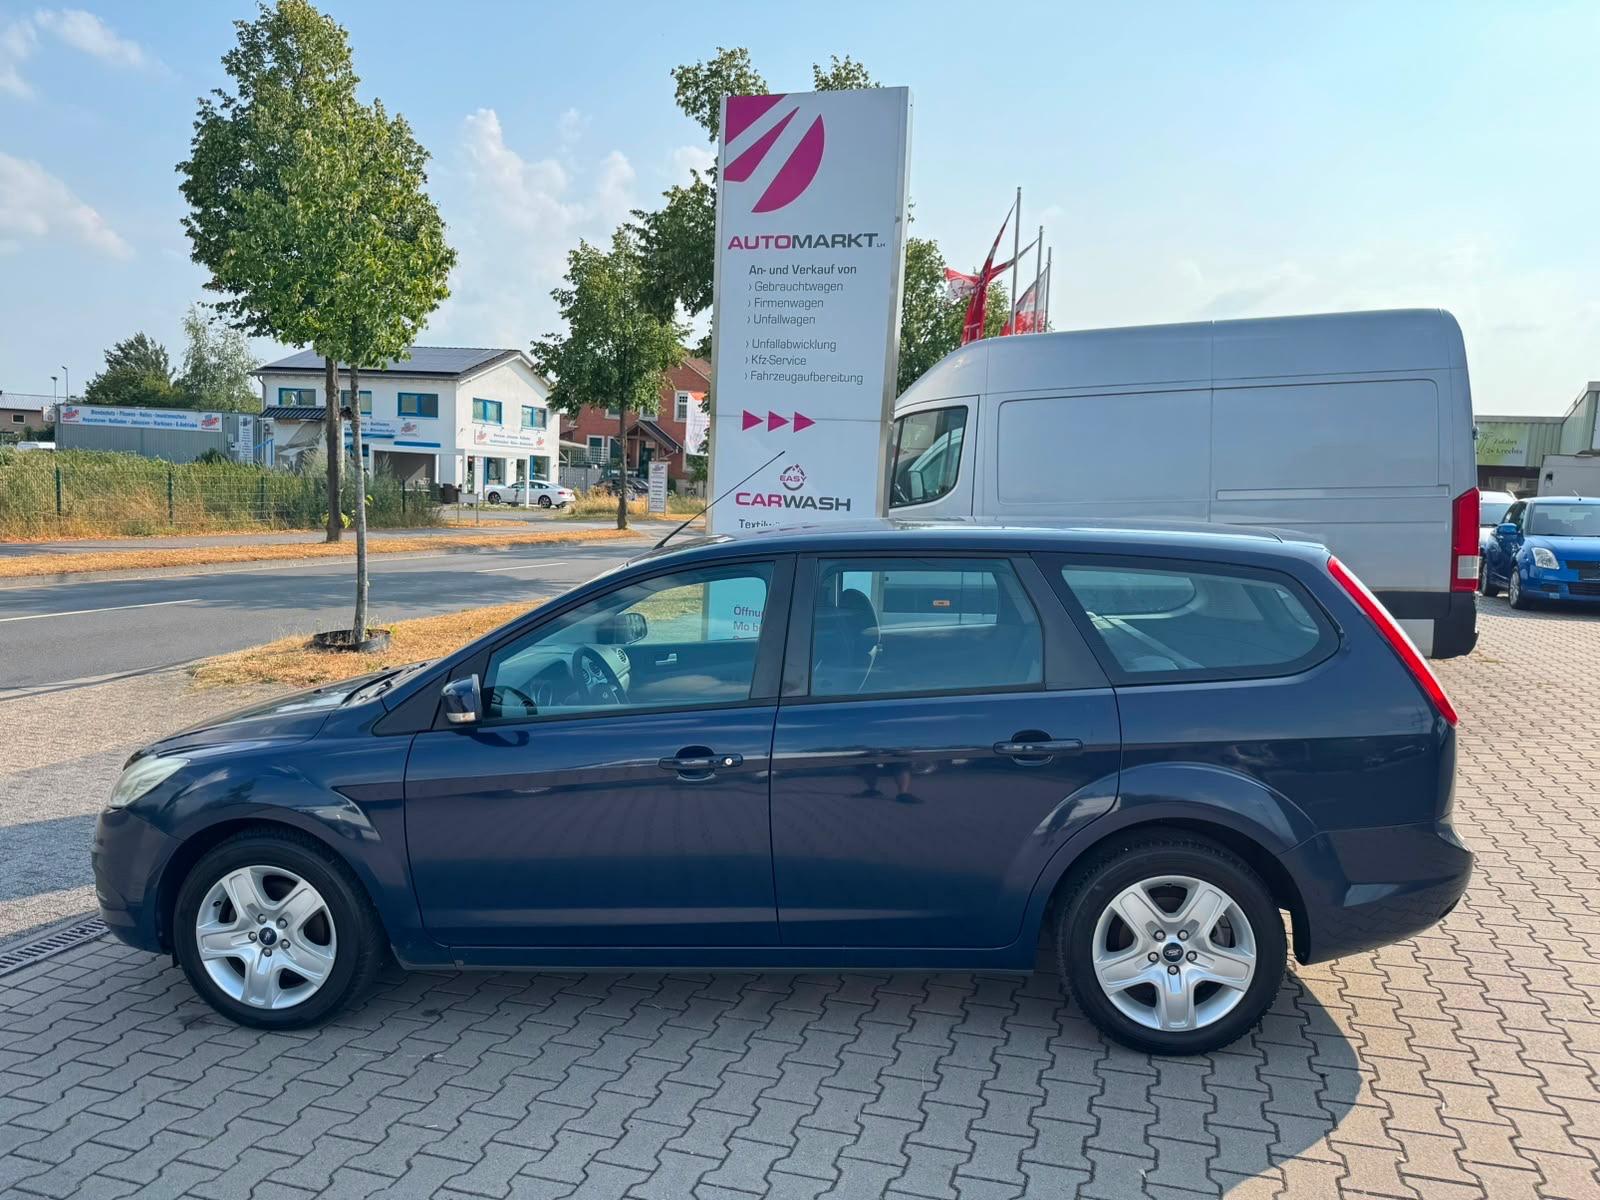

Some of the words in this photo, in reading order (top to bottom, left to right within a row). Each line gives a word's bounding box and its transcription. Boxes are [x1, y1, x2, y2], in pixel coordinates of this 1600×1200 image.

[728, 233, 878, 250] AUTOMARKT
[749, 264, 766, 275] An-
[769, 265, 788, 275] und
[791, 264, 835, 275] Verkauf
[837, 265, 857, 275] von
[754, 281, 844, 294] Gebrauchtwagen
[754, 297, 824, 310] Firmenwagen
[753, 313, 816, 326] Unfallwagen
[751, 338, 837, 352] Unfallabwicklung
[751, 355, 807, 366] Kfz-Service
[750, 371, 864, 385] Fahrzeugaufbereitung
[779, 474, 807, 483] EASY
[735, 492, 851, 511] CARWASH
[739, 518, 780, 529] Textil
[733, 604, 764, 619] Öffnu
[733, 621, 749, 632] Mo
